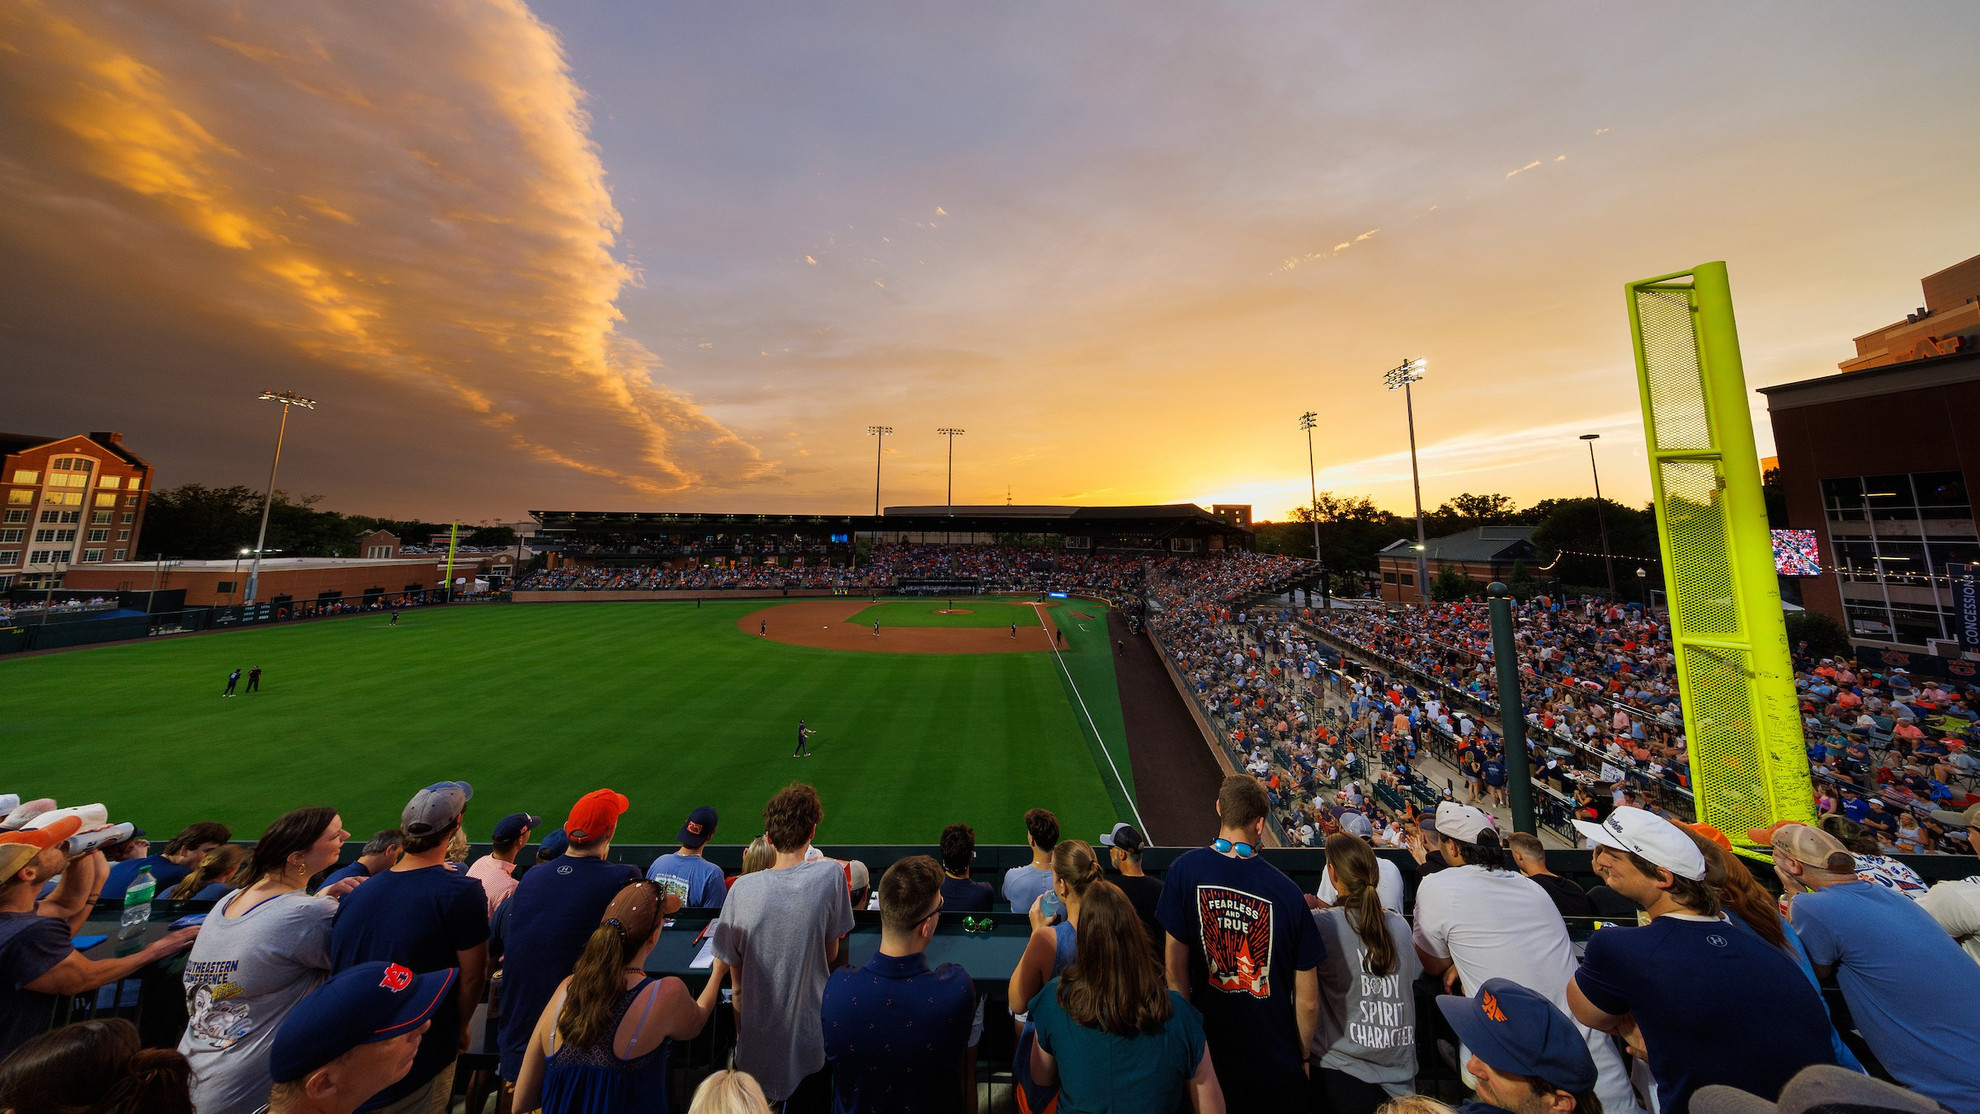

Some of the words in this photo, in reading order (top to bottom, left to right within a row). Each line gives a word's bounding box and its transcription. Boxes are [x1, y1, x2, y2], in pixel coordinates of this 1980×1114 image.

[1963, 574, 1979, 644] CONCESSIONS
[1208, 899, 1259, 920] FEARLESS
[1225, 909, 1241, 918] AND
[1217, 917, 1250, 935] TRUE
[186, 960, 240, 974] THEASTERN
[1359, 1000, 1405, 1026] SPIRIT
[1349, 1022, 1415, 1049] CHARACTER
